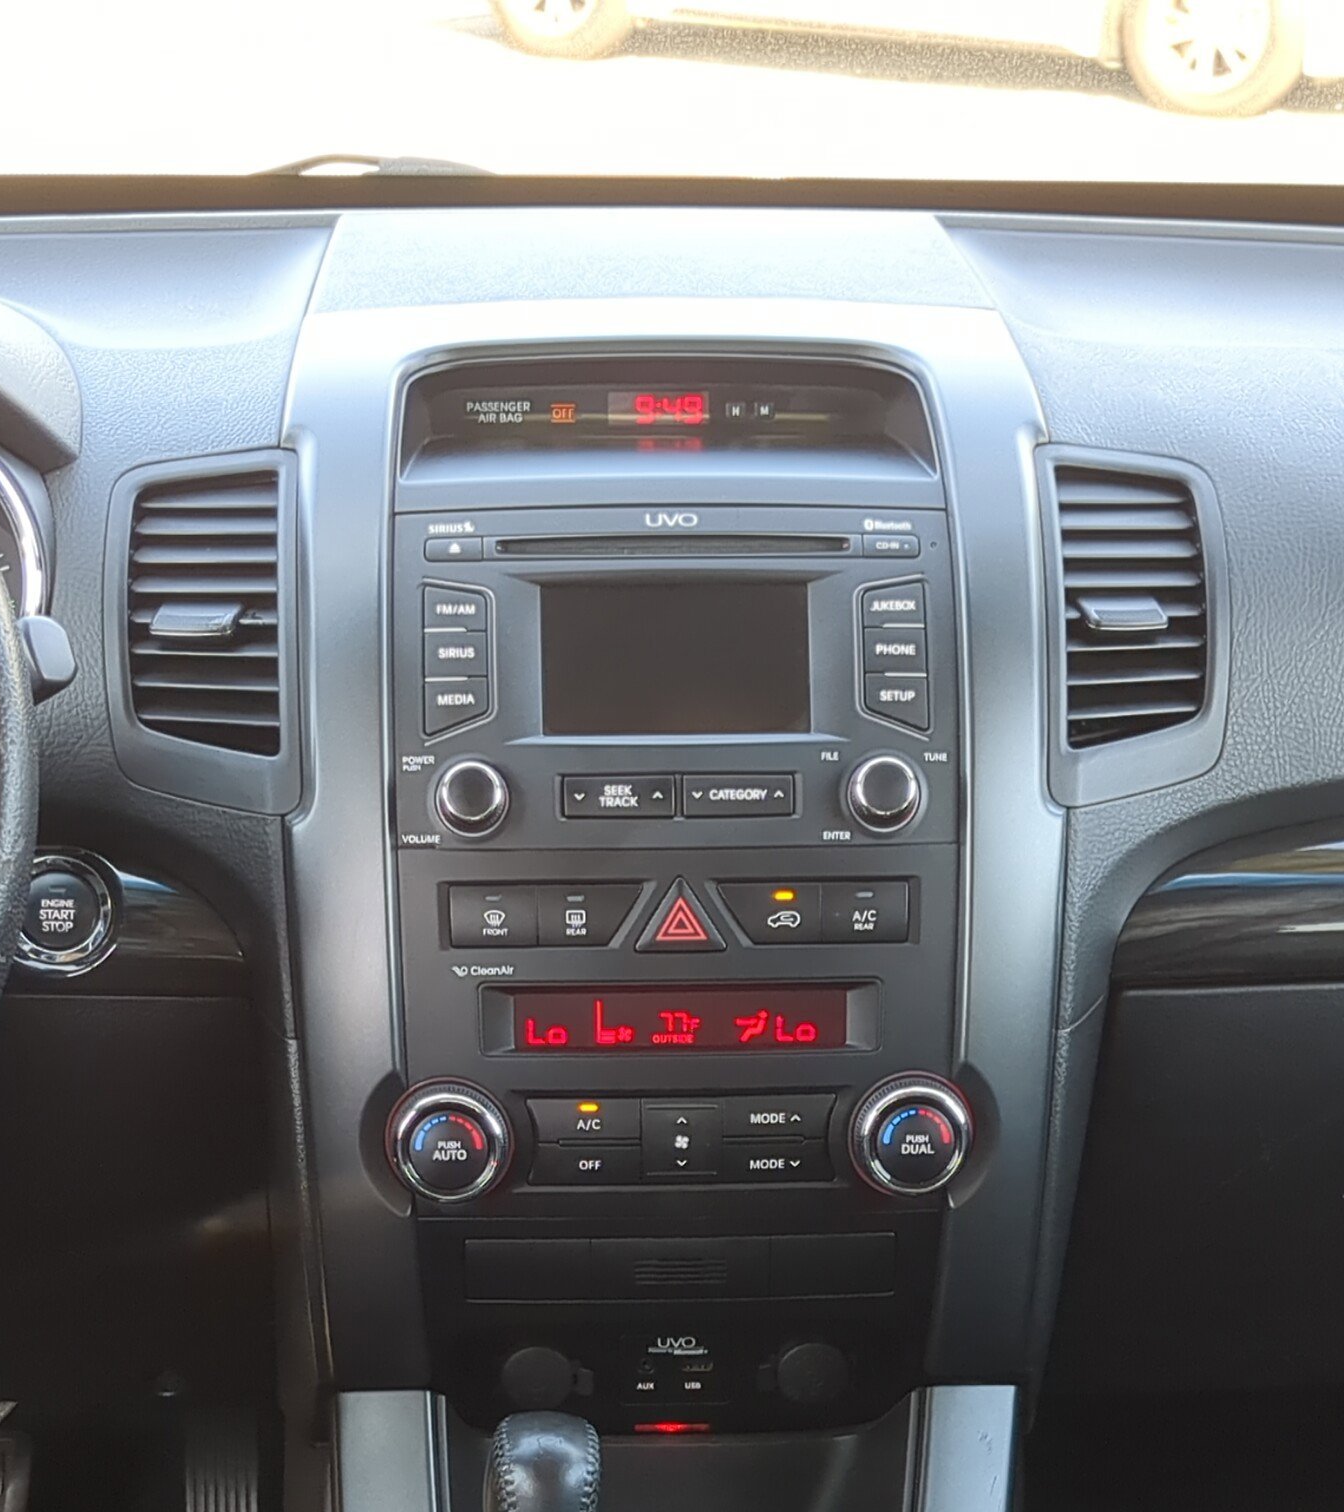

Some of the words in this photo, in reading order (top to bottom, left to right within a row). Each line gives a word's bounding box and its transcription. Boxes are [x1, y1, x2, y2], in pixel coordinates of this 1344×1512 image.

[466, 401, 531, 413] PASSENGER
[635, 394, 703, 424] 9:49
[732, 405, 740, 417] H
[760, 405, 769, 416] M
[477, 413, 497, 424] AIR
[499, 413, 523, 424] BAG
[552, 408, 574, 419] OFF
[644, 513, 698, 527] UVO
[428, 523, 463, 535] SIRIUS
[436, 603, 476, 615] FM/AM
[869, 600, 916, 611] JUKEBOX
[438, 647, 475, 659] SIRIUS
[875, 644, 916, 655] PHONE
[437, 693, 475, 706] MEDIA
[879, 690, 916, 701] SETUP
[402, 755, 435, 765] POWER
[821, 752, 839, 761] FILE
[924, 753, 948, 762] TUNE
[604, 784, 632, 796] SEEK
[709, 789, 767, 800] CATEGORY
[599, 796, 638, 808] TRACK
[401, 834, 441, 844] VOLUME
[823, 831, 851, 840] ENTER
[41, 899, 74, 907] ENGINE
[39, 909, 76, 920] START
[852, 910, 877, 922] A/C
[42, 921, 74, 932] STOP
[854, 922, 874, 930] REAR
[482, 928, 508, 936] FRONT
[565, 928, 587, 936] REAR
[471, 965, 514, 976] CleanAir
[652, 1034, 694, 1044] OUTSIDE
[750, 1113, 786, 1124] MODE
[577, 1118, 601, 1131] A/C
[905, 1134, 930, 1143] PUSH
[437, 1140, 462, 1149] PUSH
[901, 1144, 934, 1155] DUAL
[433, 1150, 467, 1161] AUTO
[579, 1160, 602, 1171] OFF
[749, 1159, 785, 1170] MODE
[657, 1336, 696, 1348] UVO
[636, 1382, 654, 1390] AUX
[684, 1382, 701, 1390] USB
